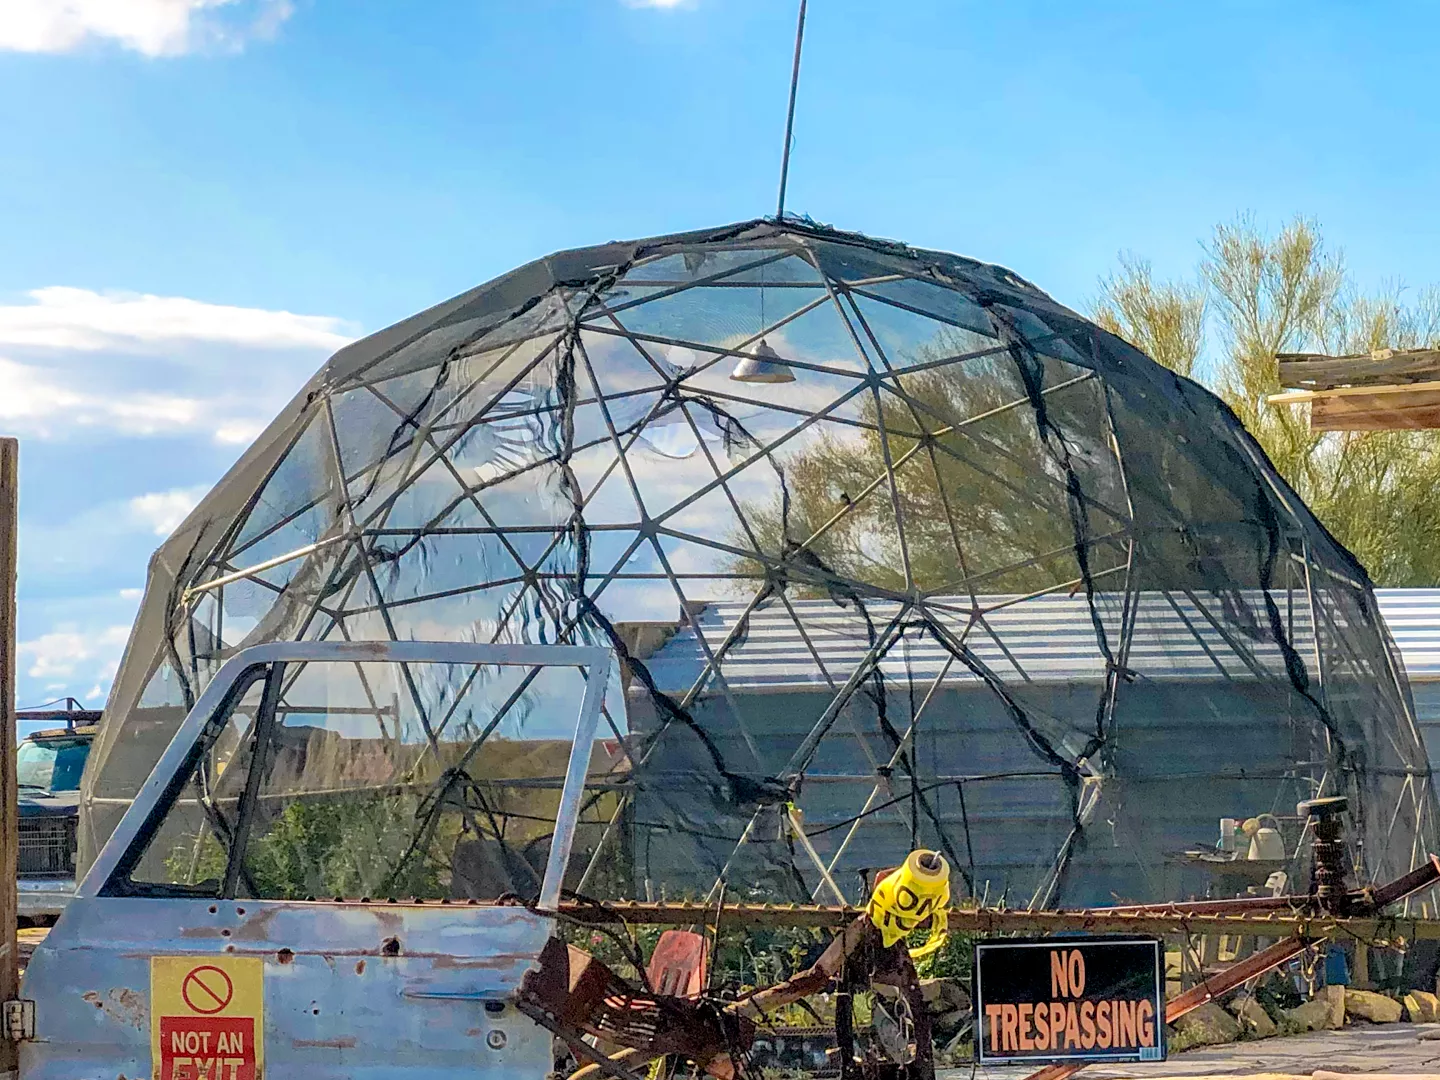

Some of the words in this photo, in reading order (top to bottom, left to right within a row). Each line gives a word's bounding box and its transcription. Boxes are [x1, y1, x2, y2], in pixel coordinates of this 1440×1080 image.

[1050, 949, 1086, 998] NO
[171, 1031, 212, 1055] NOT
[216, 1031, 244, 1055] AN
[985, 999, 1154, 1052] TRESPASSING
